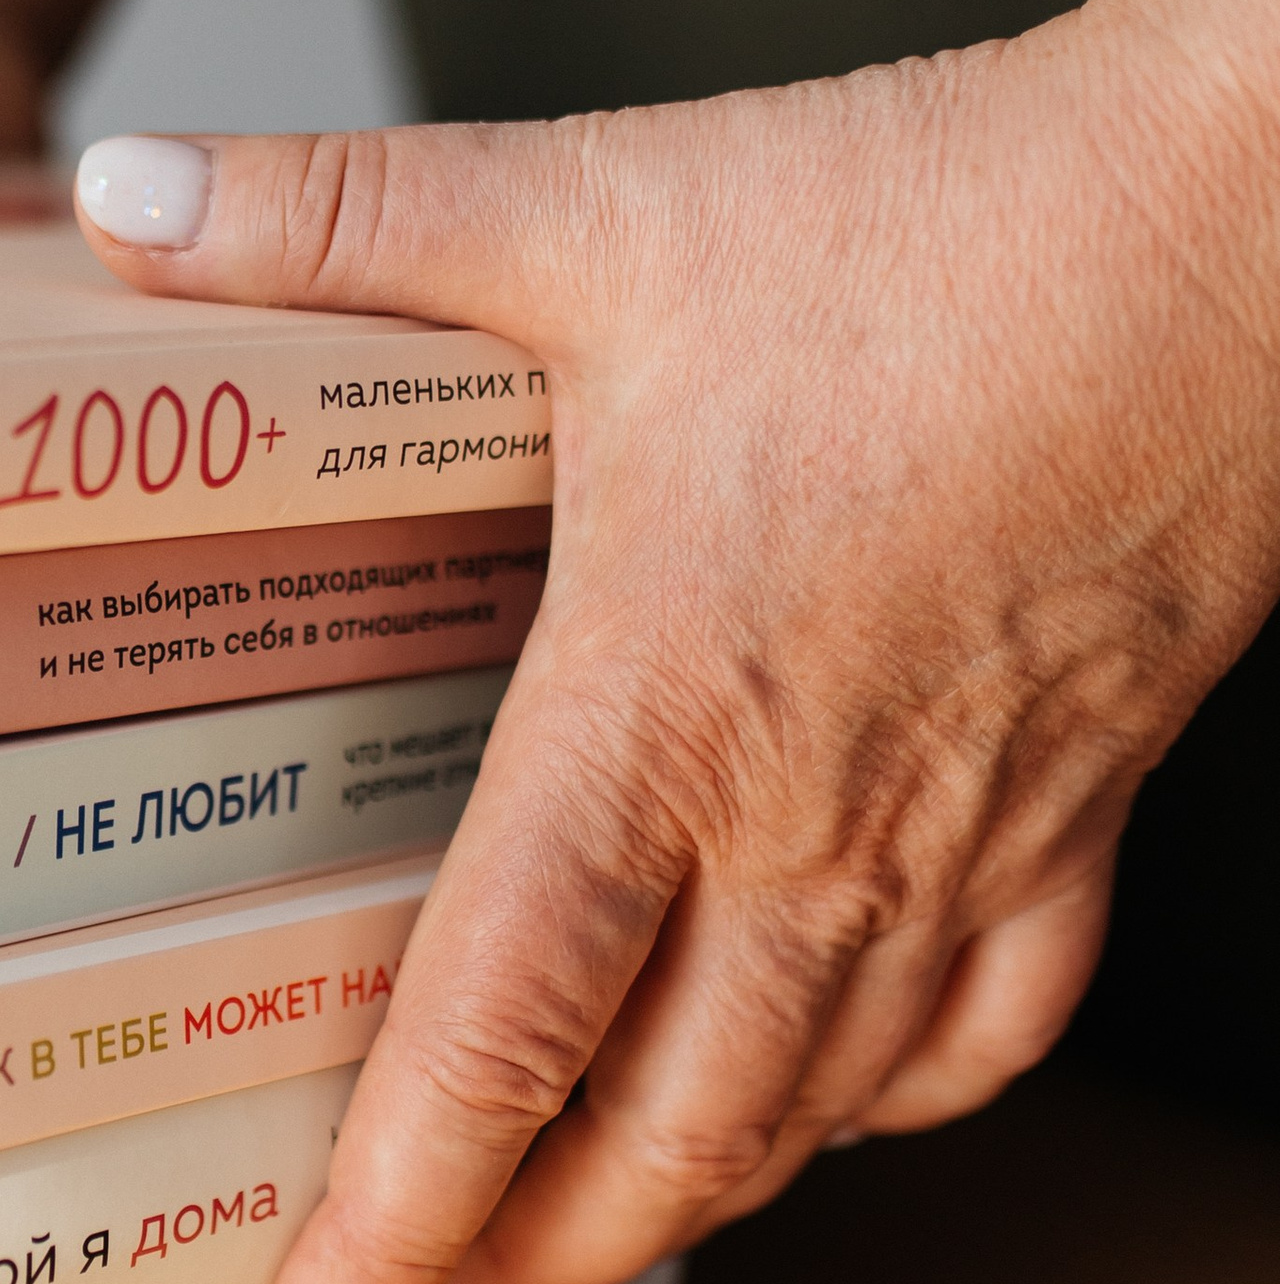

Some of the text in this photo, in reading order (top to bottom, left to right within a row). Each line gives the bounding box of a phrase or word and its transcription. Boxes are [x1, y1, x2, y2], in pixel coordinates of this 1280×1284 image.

[319, 372, 515, 410] маленьких
[317, 442, 387, 480] для
[36, 598, 94, 627] как
[102, 580, 250, 621] выбирать
[260, 557, 436, 602] подходящих
[40, 652, 58, 678] и
[68, 646, 105, 676] не
[115, 633, 215, 675] терять
[224, 618, 293, 655] себя
[304, 622, 318, 645] в
[13, 814, 38, 869] /
[55, 798, 116, 860] НЕ
[131, 762, 308, 845] ЛЮБИТ
[30, 1038, 56, 1081] В
[70, 1012, 169, 1070] ТЕБЕ
[184, 976, 328, 1045] МОЖЕТ
[342, 959, 401, 1009] НА
[79, 1228, 110, 1275] я
[131, 1181, 280, 1268] дома
